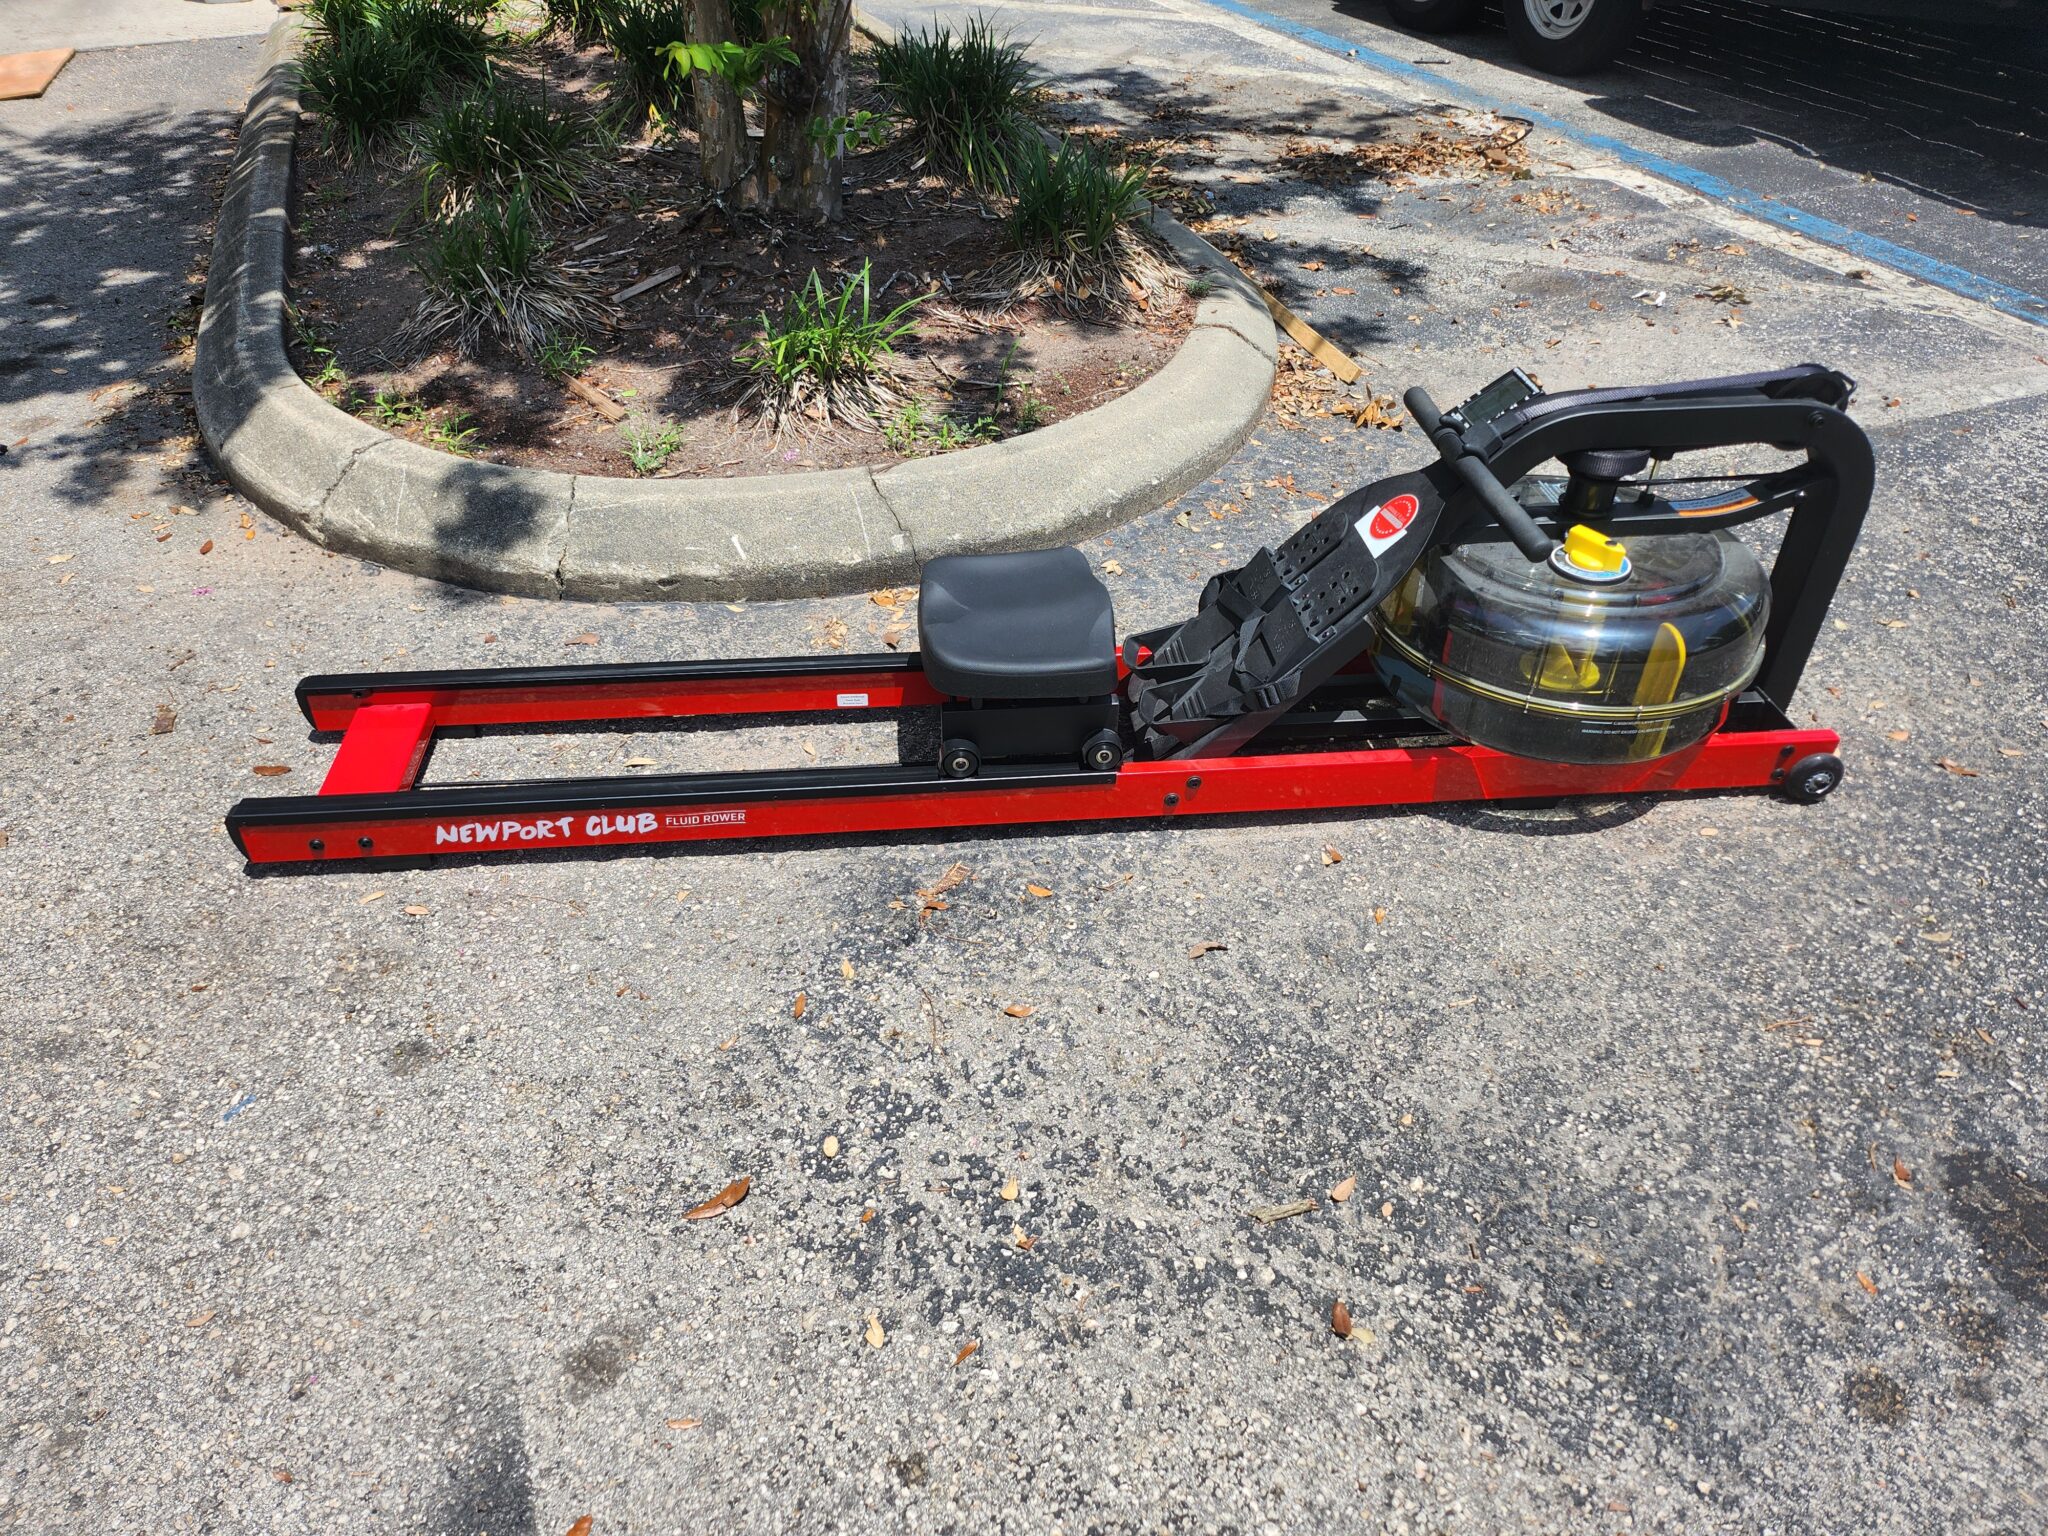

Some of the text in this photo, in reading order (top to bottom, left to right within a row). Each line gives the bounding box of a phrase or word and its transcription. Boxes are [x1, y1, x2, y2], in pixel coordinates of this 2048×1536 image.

[585, 813, 658, 837] CLUB
[665, 815, 700, 826] FLUID
[703, 812, 746, 824] ROWER
